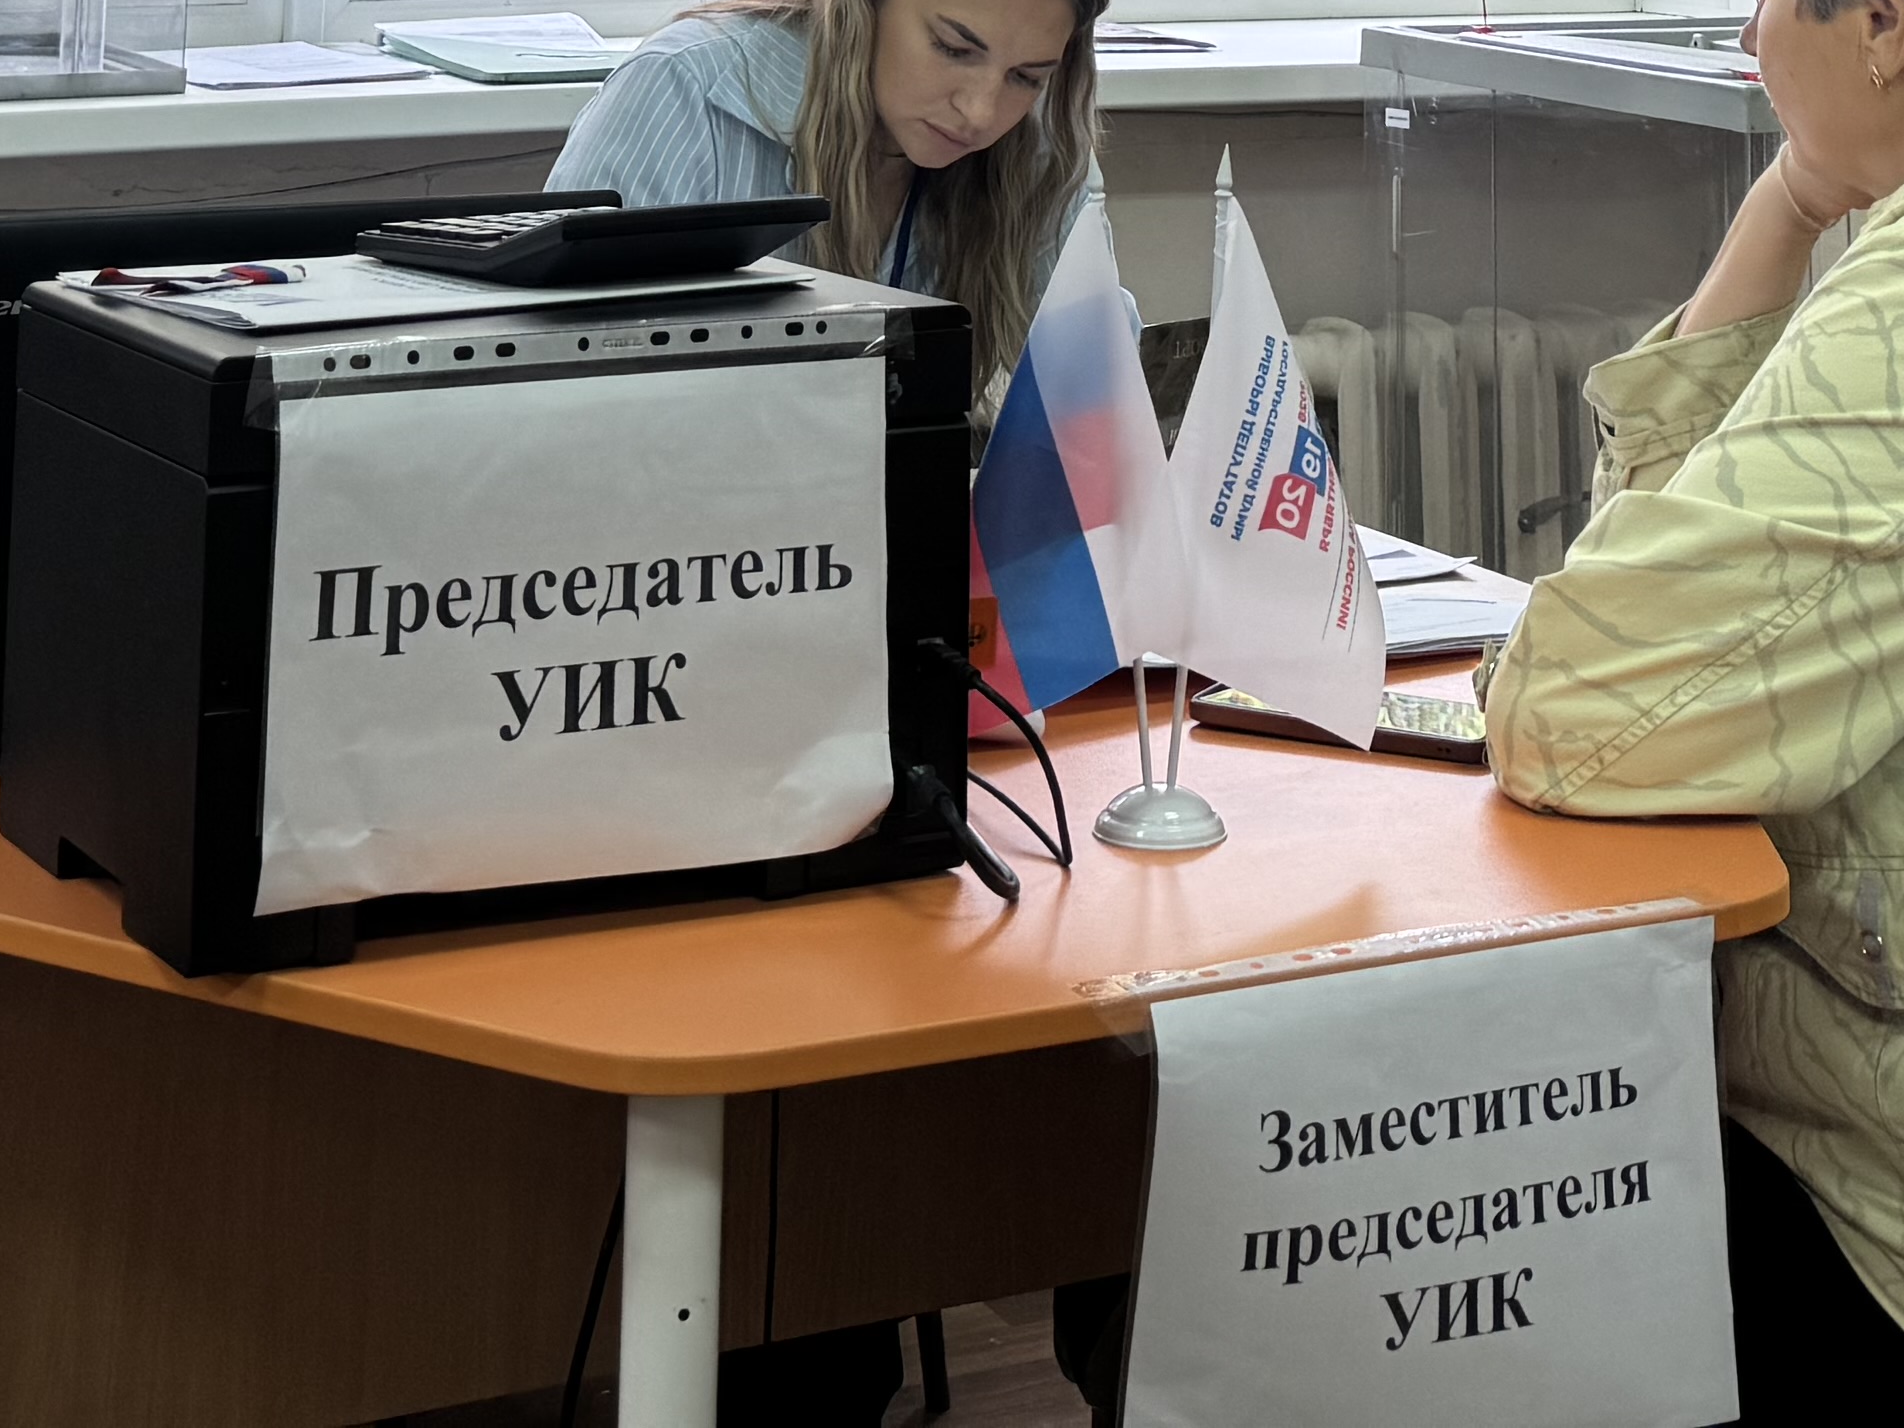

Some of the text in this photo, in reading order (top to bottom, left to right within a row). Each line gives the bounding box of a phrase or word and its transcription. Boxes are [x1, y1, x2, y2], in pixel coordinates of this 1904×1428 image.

[308, 542, 854, 657] Председатель
[490, 652, 688, 743] УИК
[1258, 1065, 1639, 1175] Заместитель
[1238, 1159, 1652, 1286] председателя
[1379, 1266, 1535, 1352] УИК
